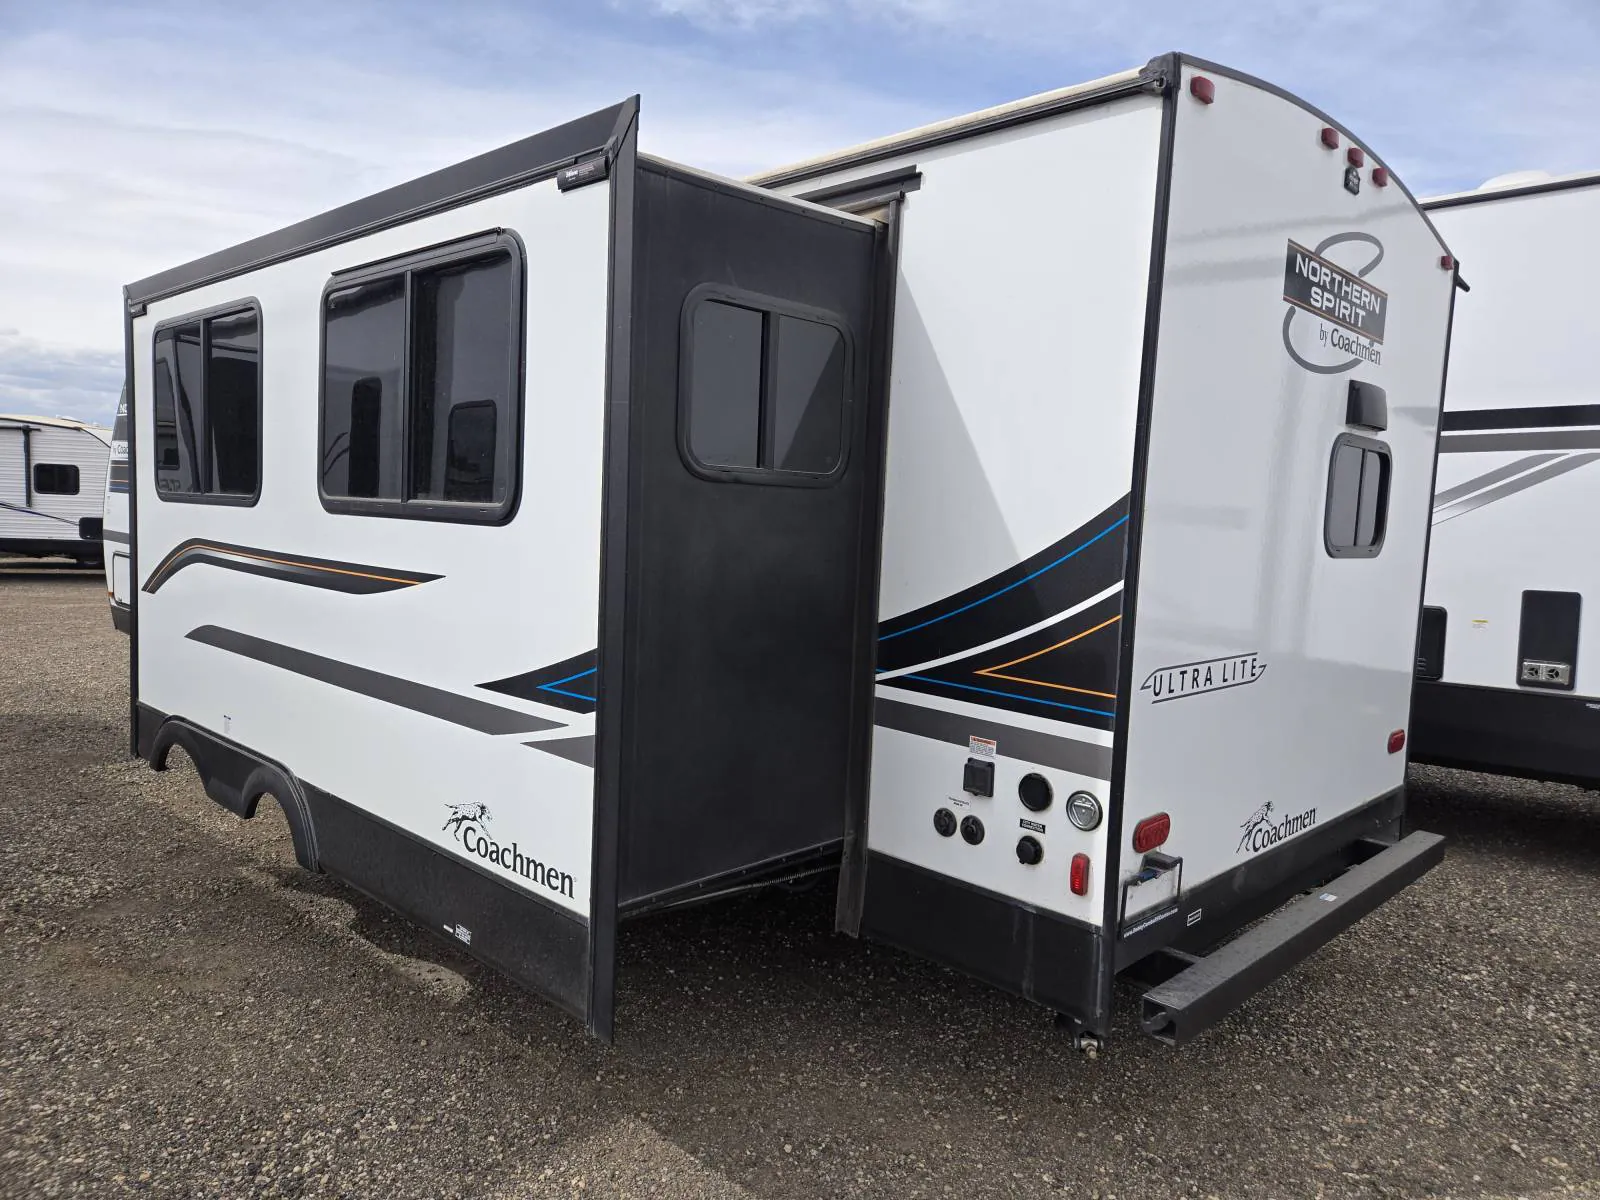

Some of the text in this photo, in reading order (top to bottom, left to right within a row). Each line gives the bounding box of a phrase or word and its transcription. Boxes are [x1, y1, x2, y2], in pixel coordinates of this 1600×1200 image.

[1295, 253, 1381, 315] NORTHERN
[1310, 286, 1366, 327] SPIRIT
[1319, 322, 1381, 366] by Coachmen
[1153, 657, 1257, 697] ULTRA LITE
[1252, 807, 1317, 853] Coachmen
[463, 826, 575, 900] Coachmen
